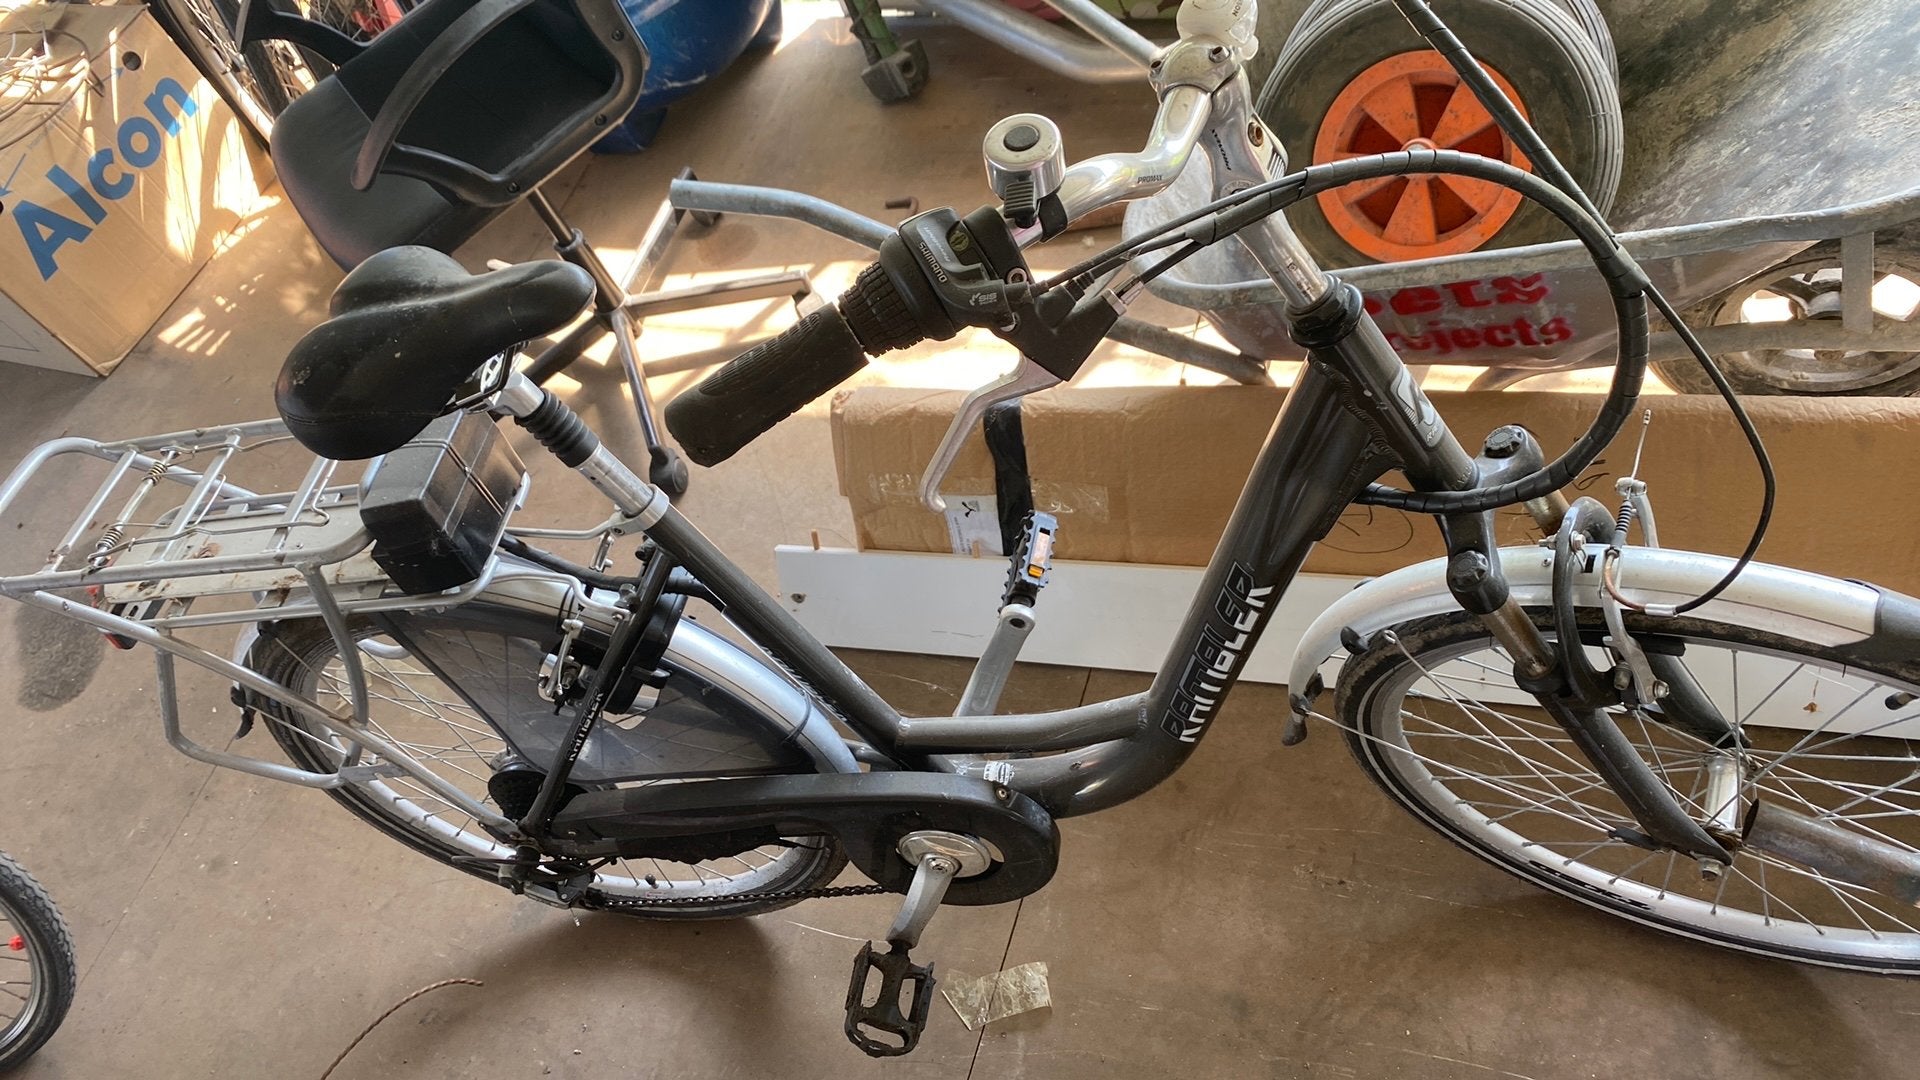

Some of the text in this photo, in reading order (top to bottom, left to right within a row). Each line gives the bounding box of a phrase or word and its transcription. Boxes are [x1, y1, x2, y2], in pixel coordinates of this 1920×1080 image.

[11, 76, 197, 283] Alcon
[1137, 173, 1163, 184] PROMAX
[919, 241, 948, 284] SHIMANO
[1364, 272, 1548, 316] ets
[1160, 561, 1276, 742] RAMBLER
[566, 686, 604, 761] RAMBLER
